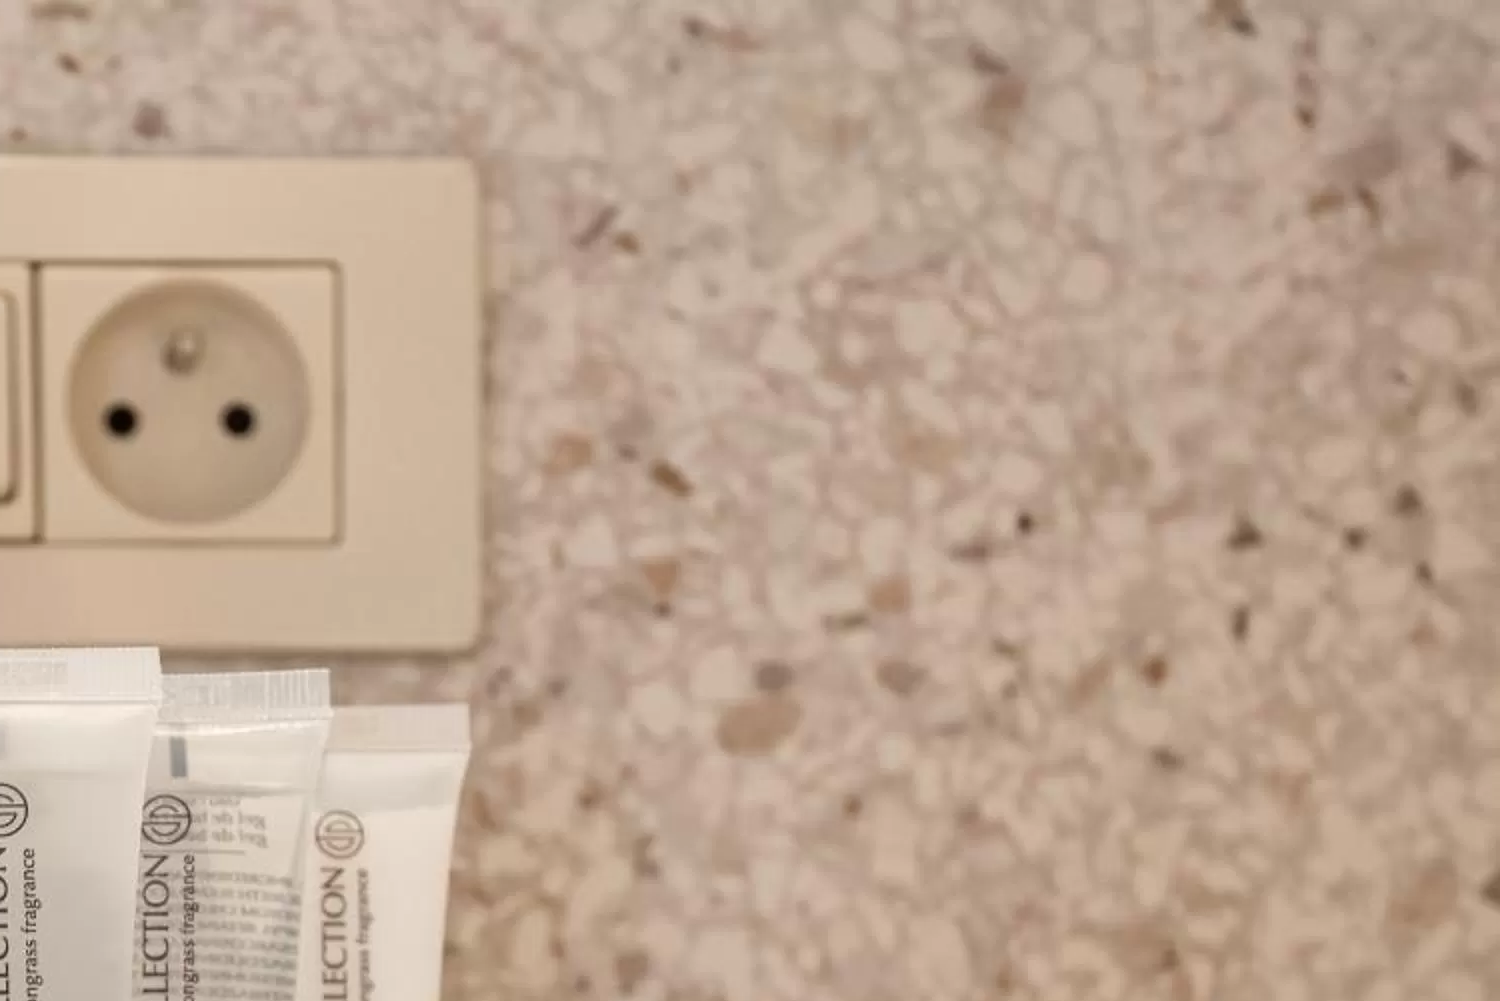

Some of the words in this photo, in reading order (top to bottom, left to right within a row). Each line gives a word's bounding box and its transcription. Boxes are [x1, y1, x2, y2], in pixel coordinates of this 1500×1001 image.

[20, 848, 42, 934] fragrance
[177, 853, 199, 935] fragrance
[355, 867, 375, 944] fragrance
